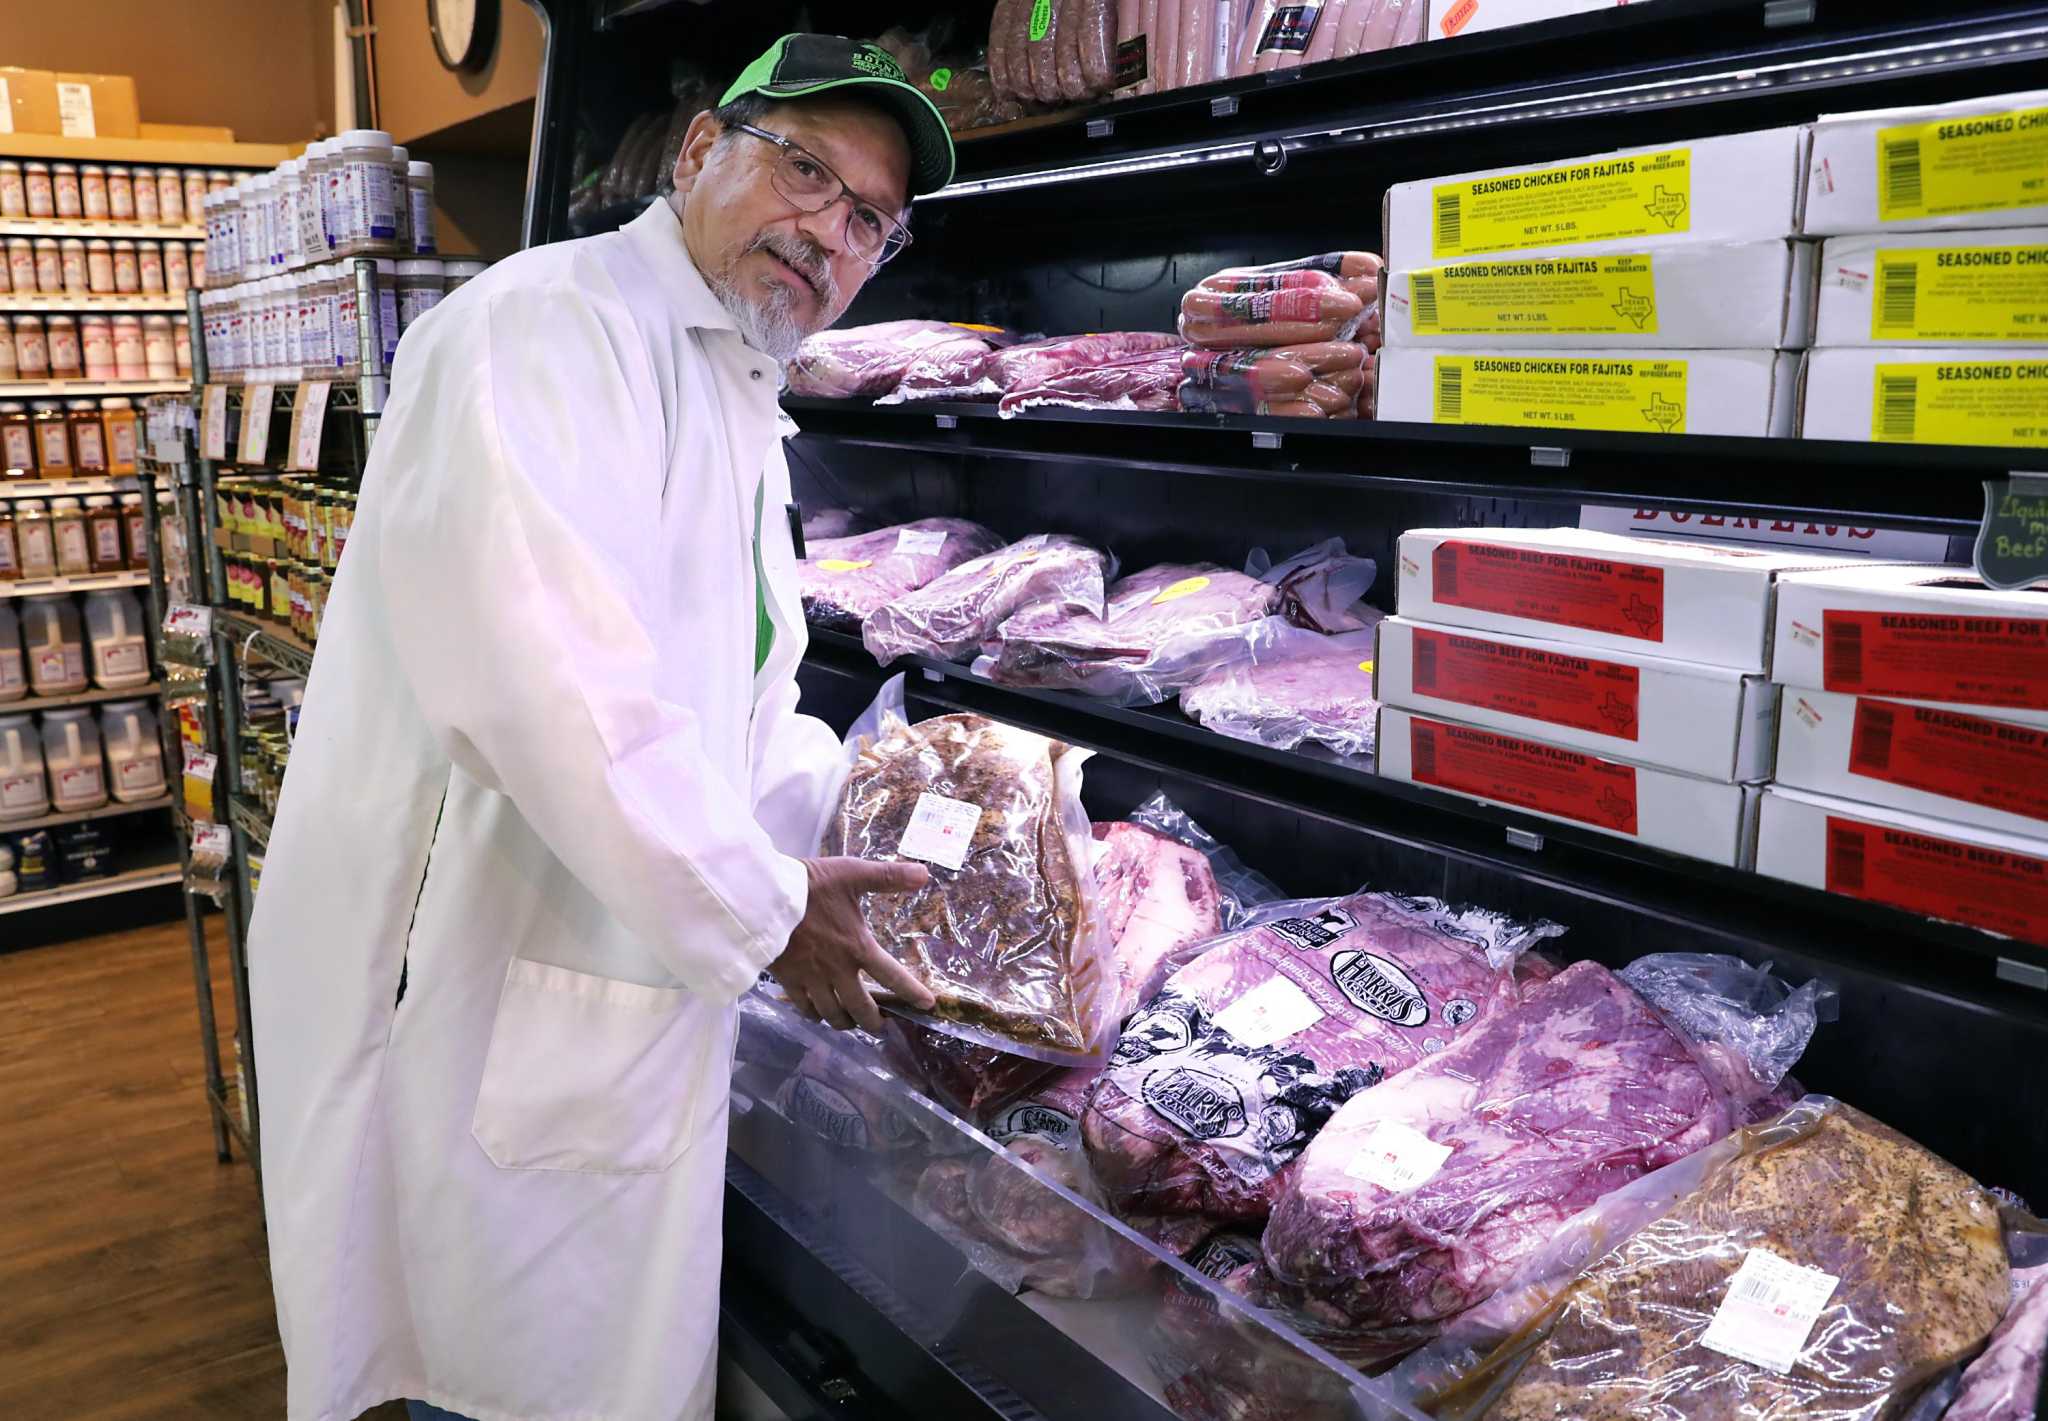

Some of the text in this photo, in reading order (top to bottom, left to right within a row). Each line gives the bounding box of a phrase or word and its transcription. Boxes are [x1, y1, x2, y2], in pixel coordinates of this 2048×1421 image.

[1938, 118, 2014, 141] SEASONED
[1472, 160, 1635, 196] SEASONED CHICKEN FOR FAJITAS
[1524, 225, 1539, 236] NET
[1444, 260, 1598, 279] SEASONED CHICKEN FOR FAJITAS
[1937, 251, 2012, 267] SEASONED
[1497, 313, 1511, 322] NET
[1473, 360, 1634, 377] SEASONED CHICKEN FOR FAJITAS
[1937, 365, 2012, 381] SEASONED
[1523, 411, 1538, 420] NET
[1995, 535, 2047, 558] Beef
[1468, 544, 1518, 561] SEASONED
[1520, 549, 1545, 564] BEEF
[1548, 553, 1568, 569] FOR
[1570, 557, 1613, 575] FAJITAS
[1881, 615, 2040, 636] SEASONED BEEF FOR
[1449, 638, 1497, 654] SEASONED
[1500, 646, 1521, 659] BEEF
[1526, 649, 1545, 663] FOR
[1548, 653, 1589, 672] FAJITAS
[1914, 707, 1993, 737] SEASONED
[1997, 725, 2037, 744] BEEF
[1446, 726, 1494, 746] SEASONED
[1496, 737, 1520, 751] BEEF
[1523, 743, 1544, 757] FOR
[1545, 748, 1586, 766] FAJITAS
[1884, 831, 1963, 858] SEASONED
[1967, 848, 2005, 865] BEEF
[2011, 858, 2045, 875] FOR
[1334, 949, 1425, 1022] HARRIS
[1346, 980, 1391, 1017] RANCH
